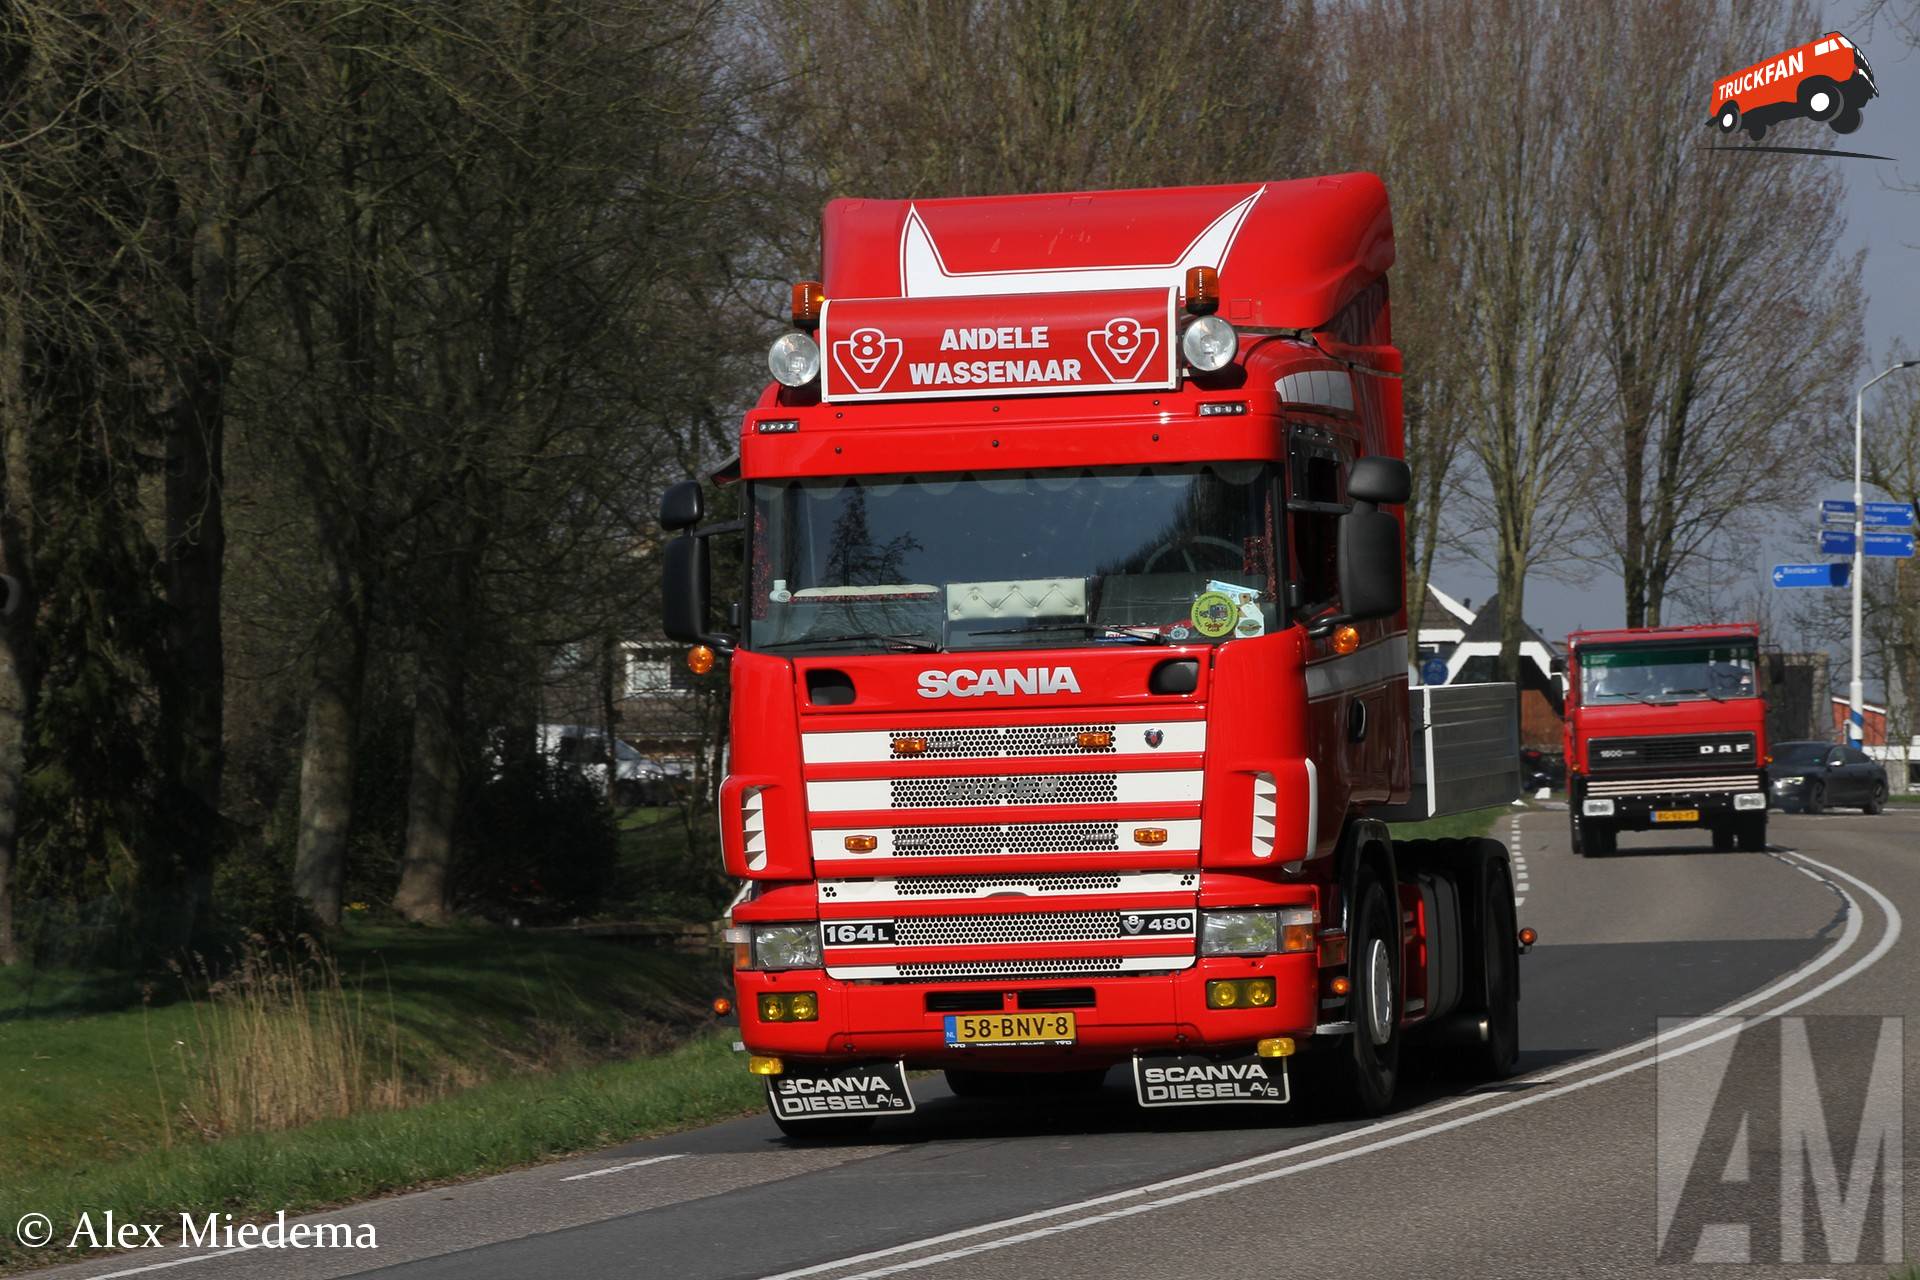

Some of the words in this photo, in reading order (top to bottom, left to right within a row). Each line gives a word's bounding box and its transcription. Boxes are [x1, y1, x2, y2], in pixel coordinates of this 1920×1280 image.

[939, 325, 1050, 352] ANDELE
[909, 358, 1082, 386] WASSENAAR
[916, 666, 1082, 699] SCANIA
[1699, 743, 1751, 754] DAF
[945, 778, 1060, 801] SUPER
[1148, 917, 1191, 931] 480
[826, 924, 889, 944] 164L
[946, 1031, 956, 1039] NL
[963, 1016, 1069, 1039] 58-BNV-8
[1145, 1064, 1269, 1083] SCANVA
[777, 1076, 892, 1095] SCANVA
[1147, 1083, 1252, 1101] DIESEL
[782, 1095, 880, 1113] DIESEL
